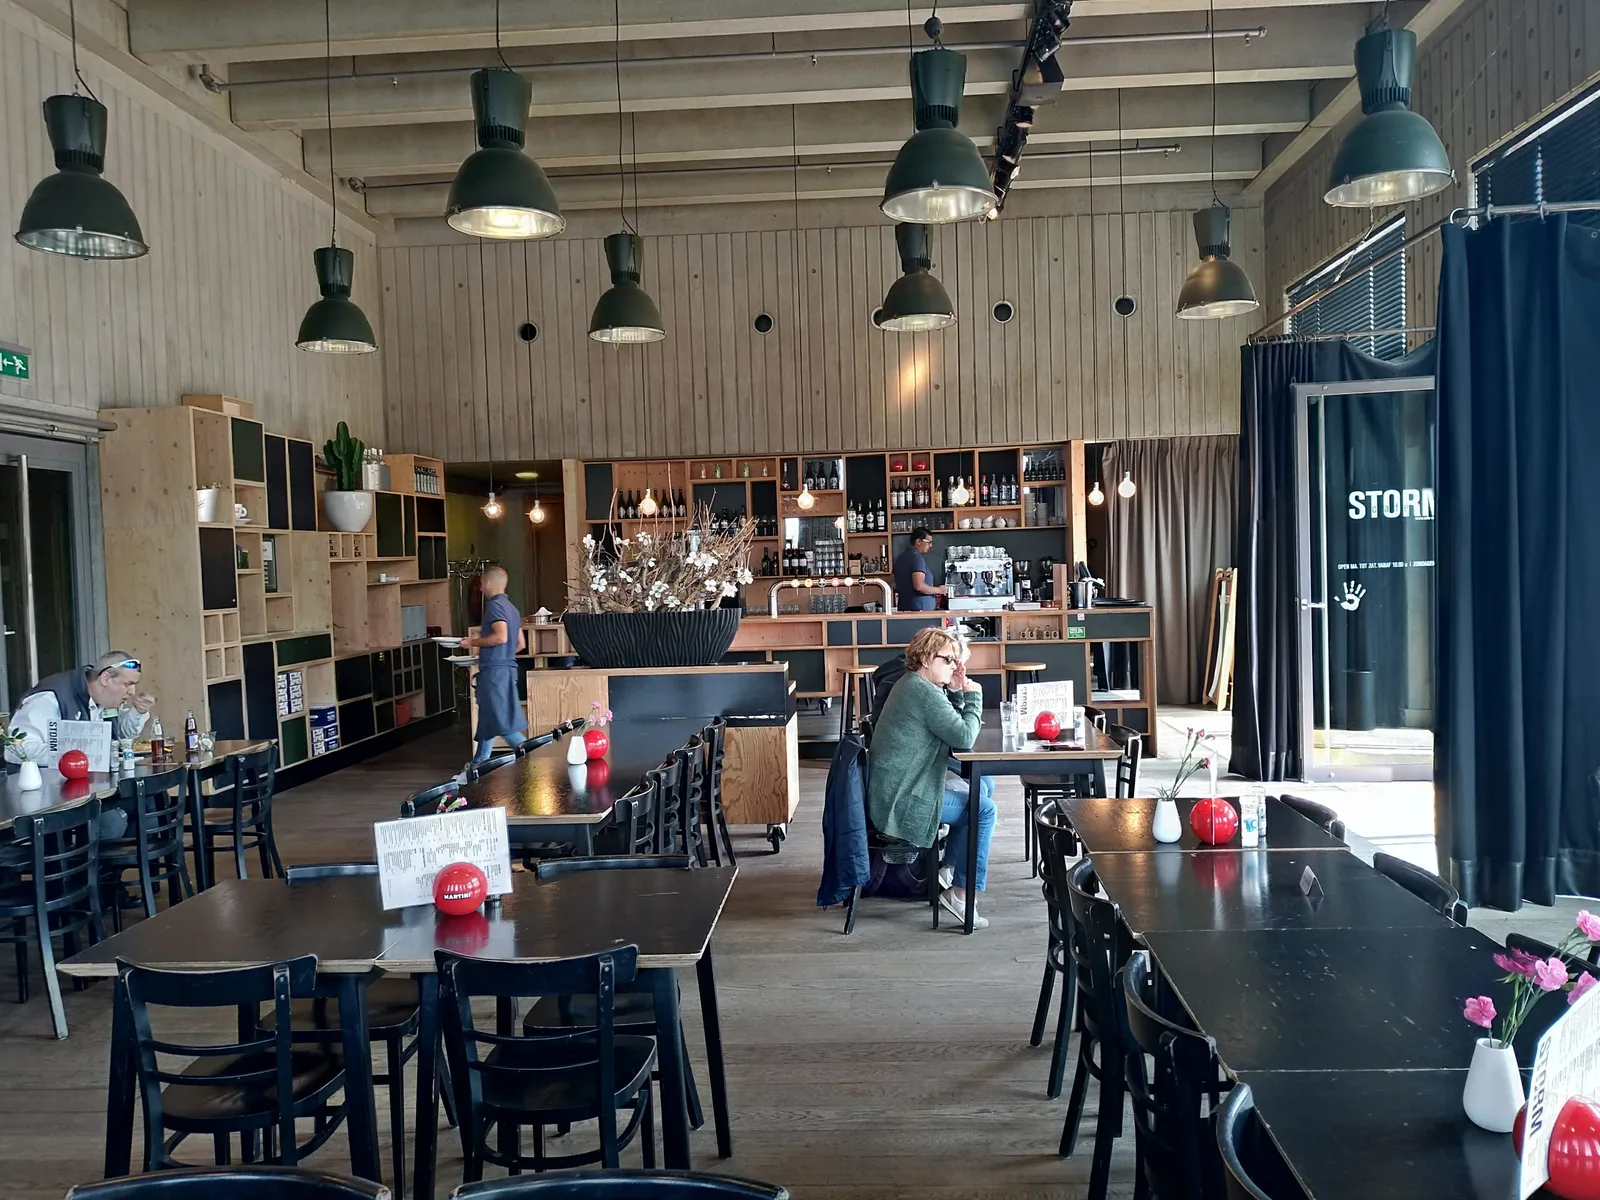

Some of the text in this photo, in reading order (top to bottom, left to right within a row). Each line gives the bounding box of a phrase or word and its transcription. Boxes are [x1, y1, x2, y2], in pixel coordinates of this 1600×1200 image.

[1348, 488, 1435, 520] STORM
[49, 721, 58, 752] STORM
[443, 892, 471, 900] MARTINI
[1529, 1036, 1552, 1138] STORM
